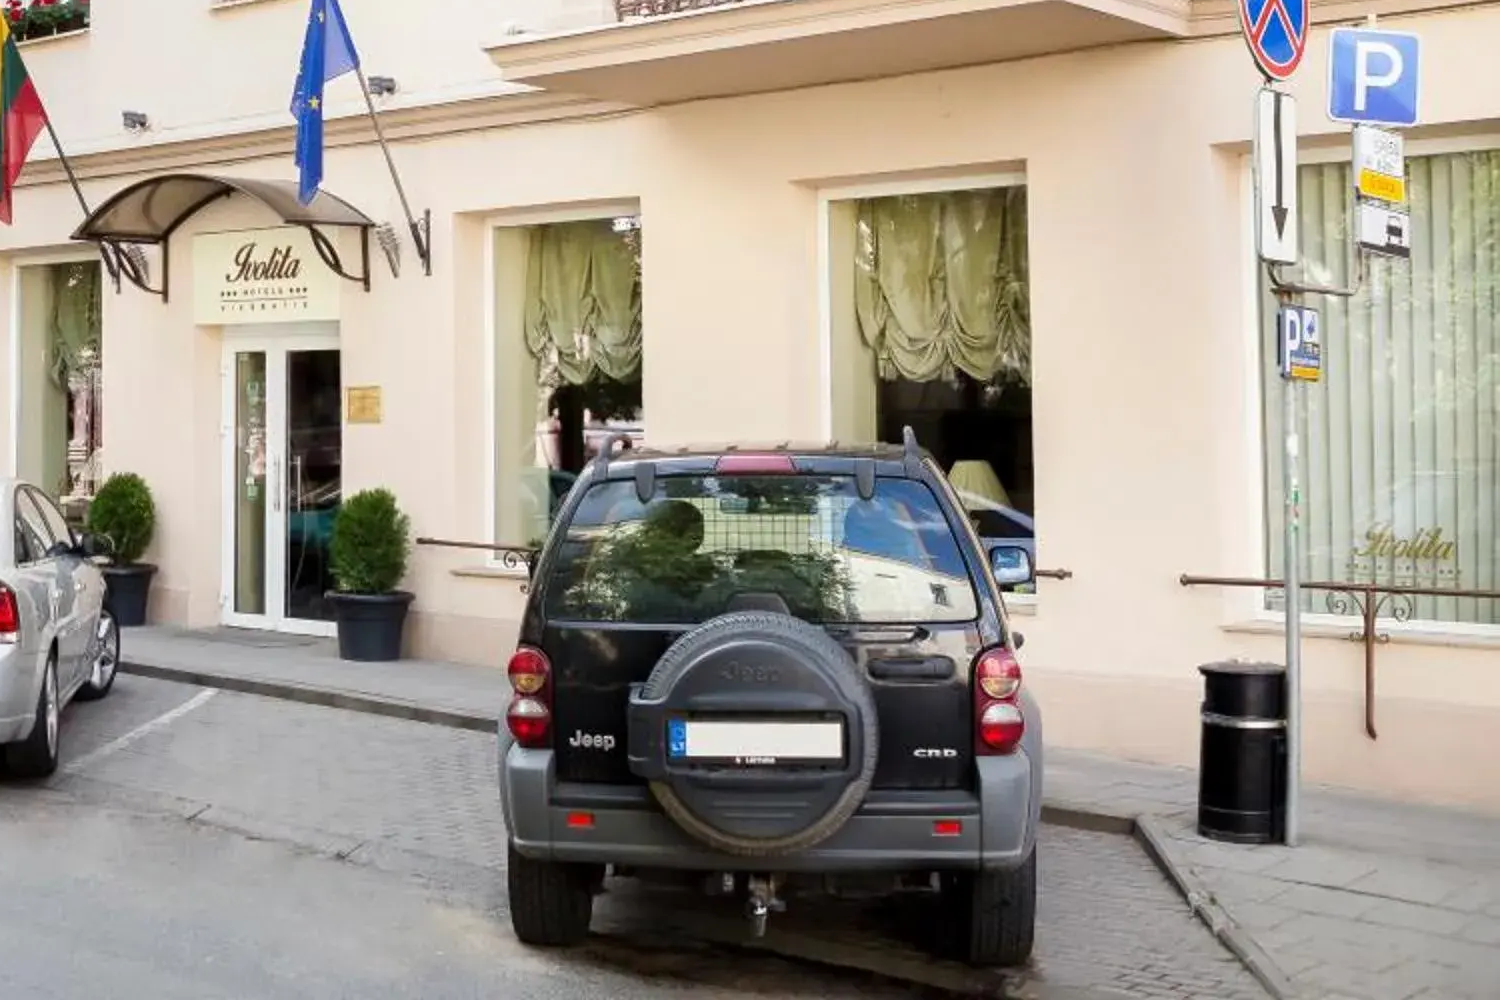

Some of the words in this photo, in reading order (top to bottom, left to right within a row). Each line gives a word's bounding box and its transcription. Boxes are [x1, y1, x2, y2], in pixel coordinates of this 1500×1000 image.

[1353, 40, 1404, 111] P
[226, 242, 300, 282] Ivolita
[1285, 309, 1301, 372] P
[569, 729, 616, 752] Jeep
